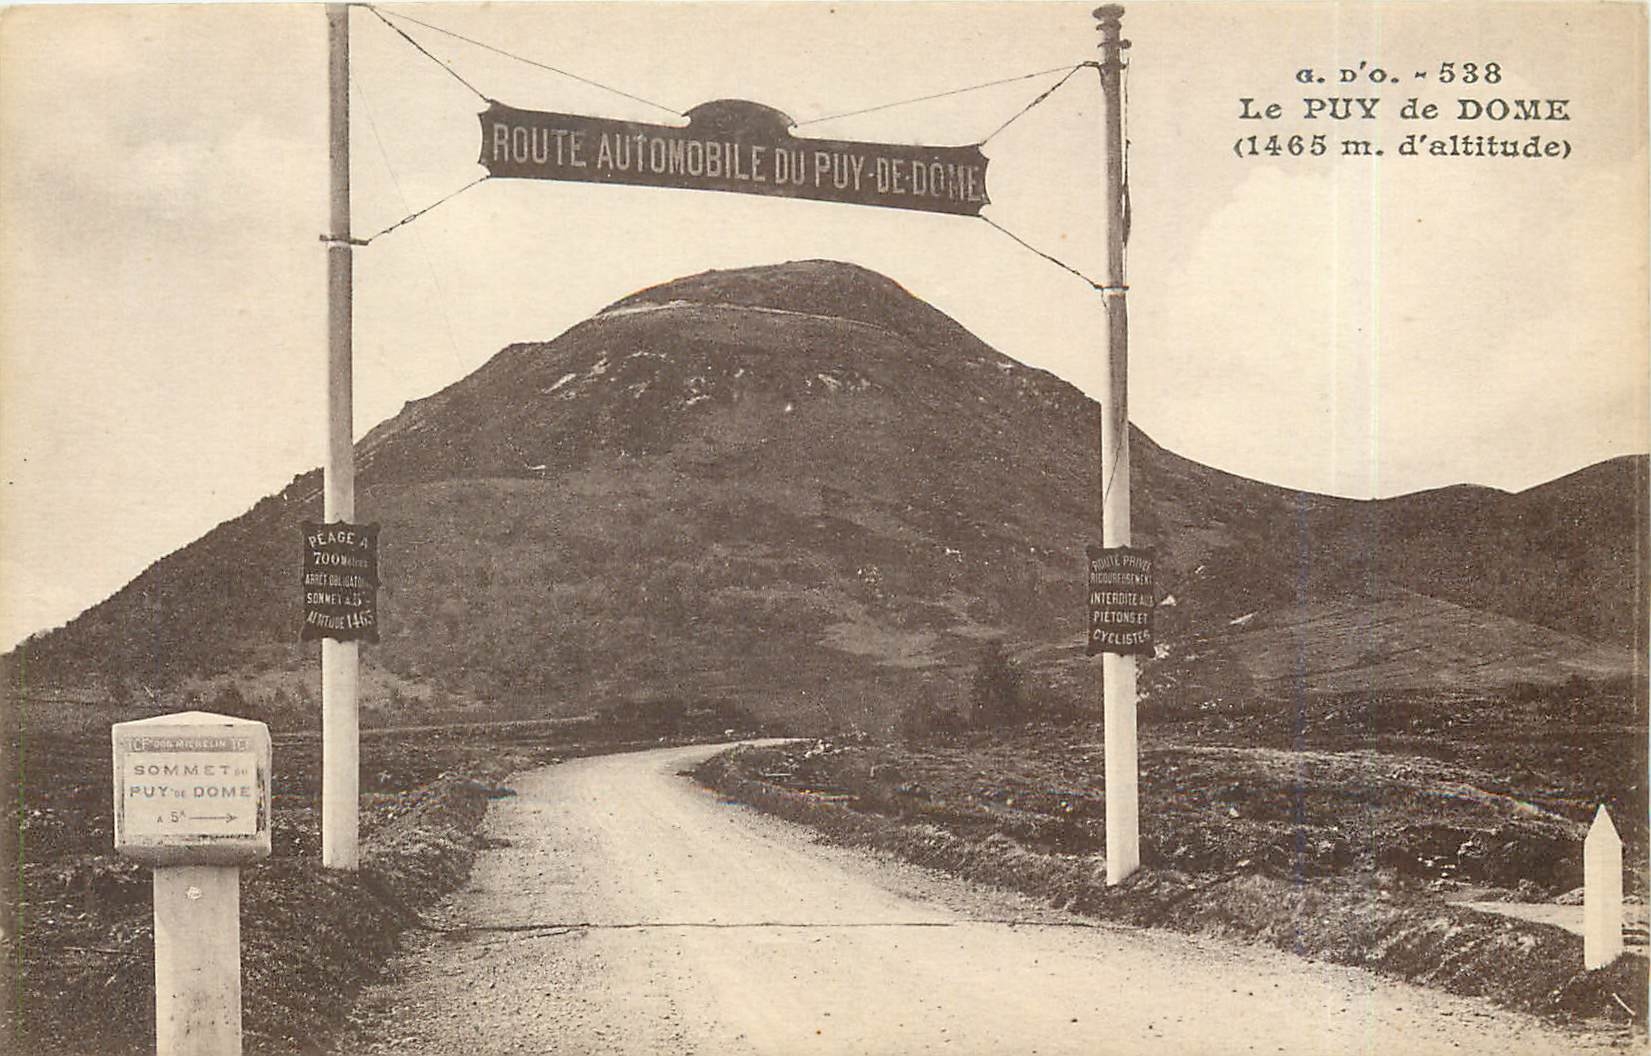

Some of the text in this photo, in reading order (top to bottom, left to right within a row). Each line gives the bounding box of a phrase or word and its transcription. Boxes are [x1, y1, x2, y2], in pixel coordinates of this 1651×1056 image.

[493, 123, 587, 168] ROUTE
[597, 133, 766, 183] AUTOMOBILE
[775, 148, 805, 185] DU
[307, 592, 342, 605] SOMMET
[1090, 592, 1137, 606] INTERDITE
[1093, 610, 1148, 625] PIETONS ET
[1093, 628, 1151, 645] CYCLISTES
[134, 765, 231, 777] SOMMET
[193, 786, 250, 798] DOME
